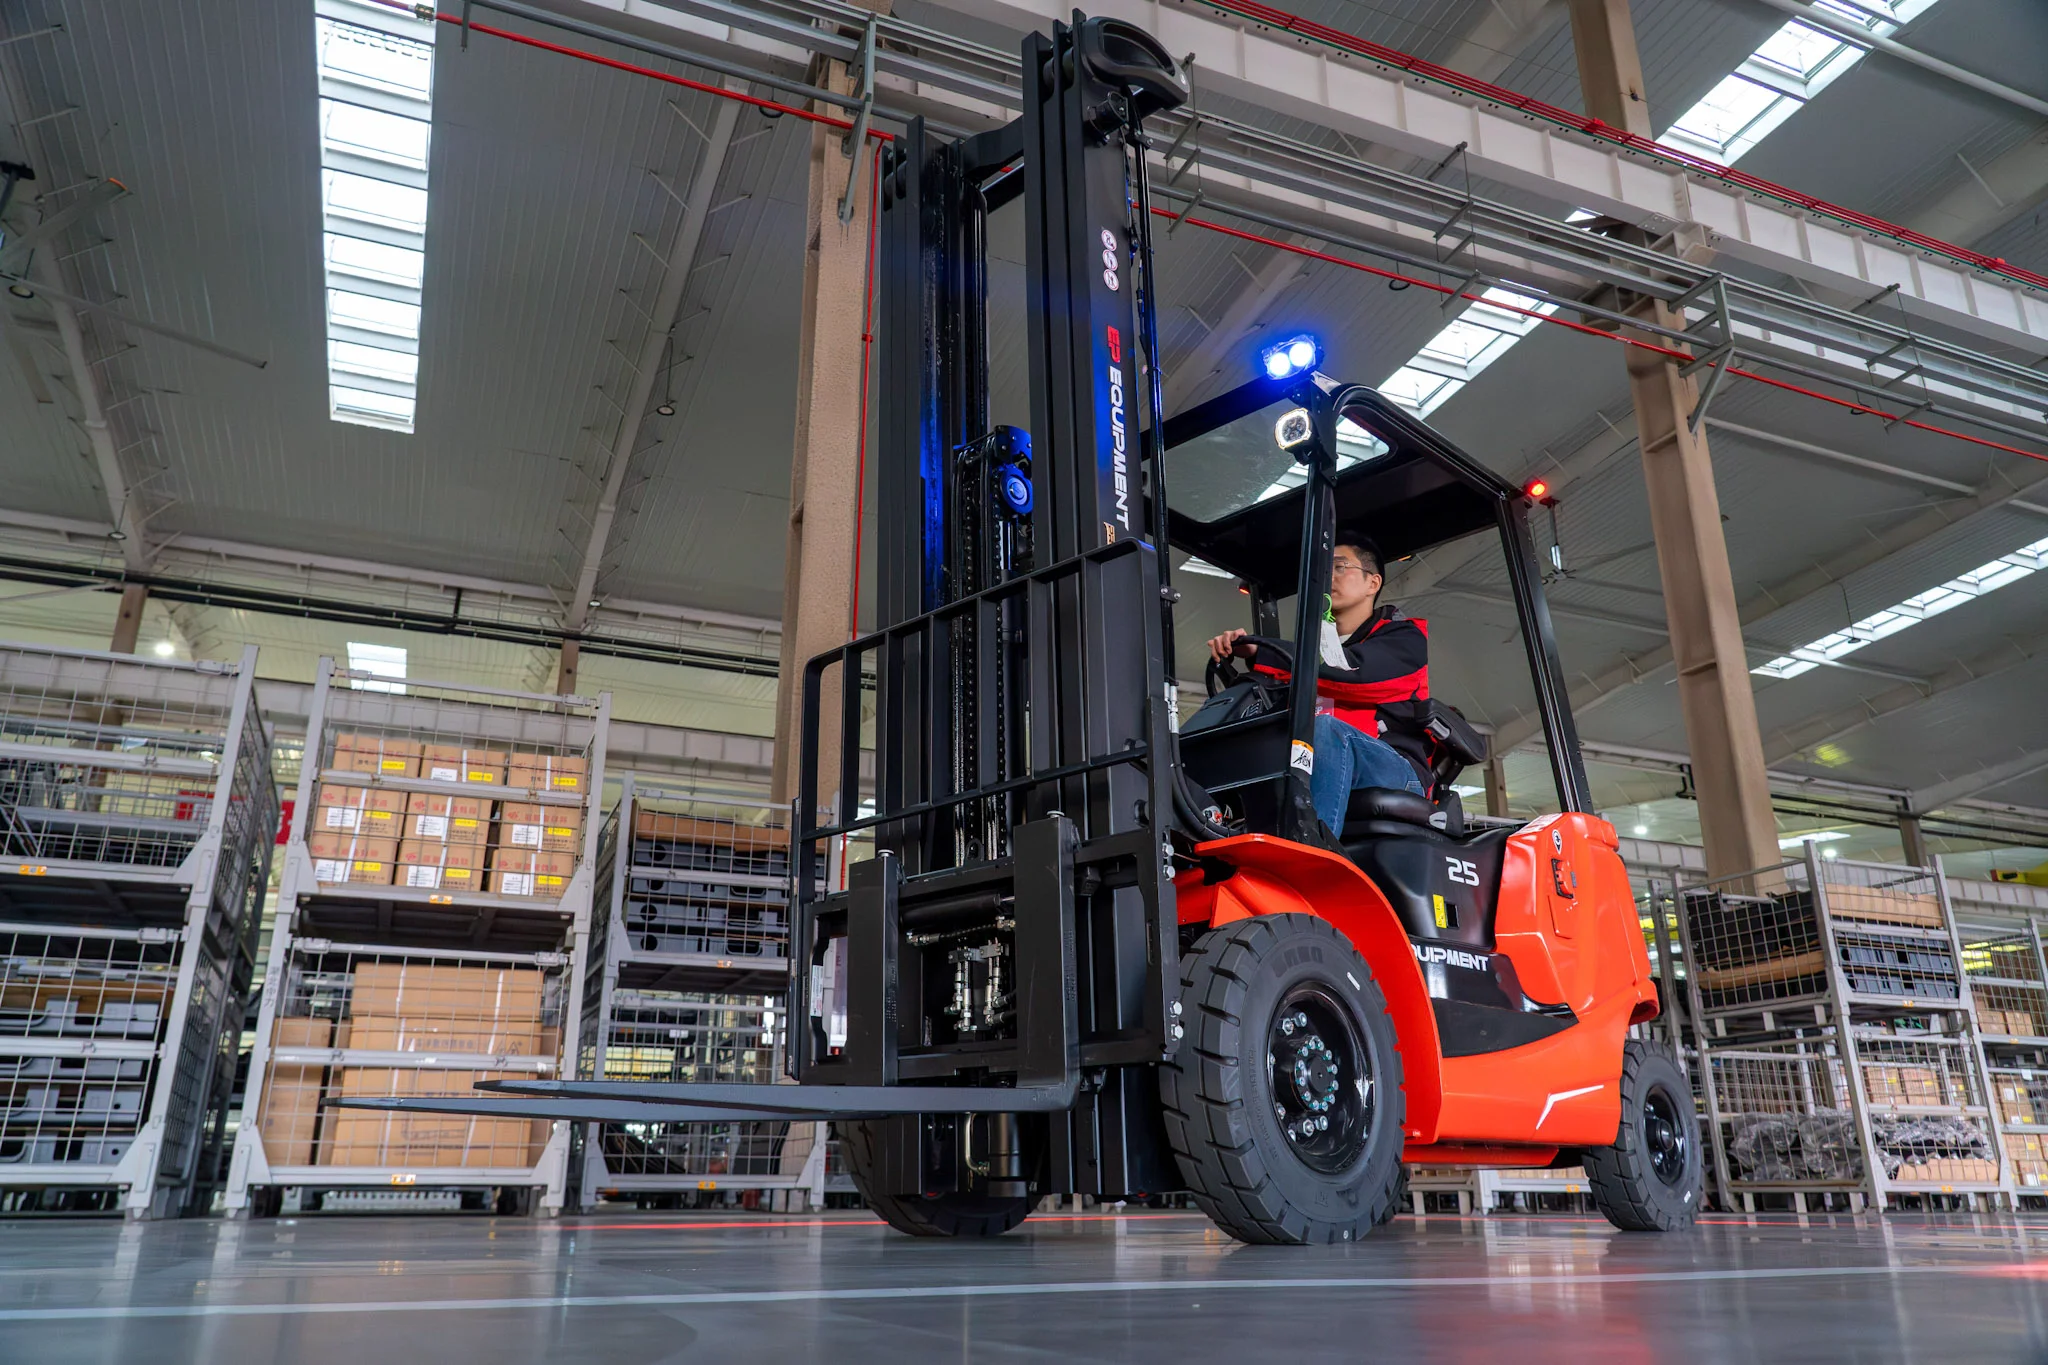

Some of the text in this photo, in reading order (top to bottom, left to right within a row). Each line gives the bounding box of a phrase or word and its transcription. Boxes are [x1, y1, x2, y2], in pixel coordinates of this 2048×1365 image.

[1107, 325, 1129, 531] EP EQUIPMENT
[1445, 855, 1480, 887] 25
